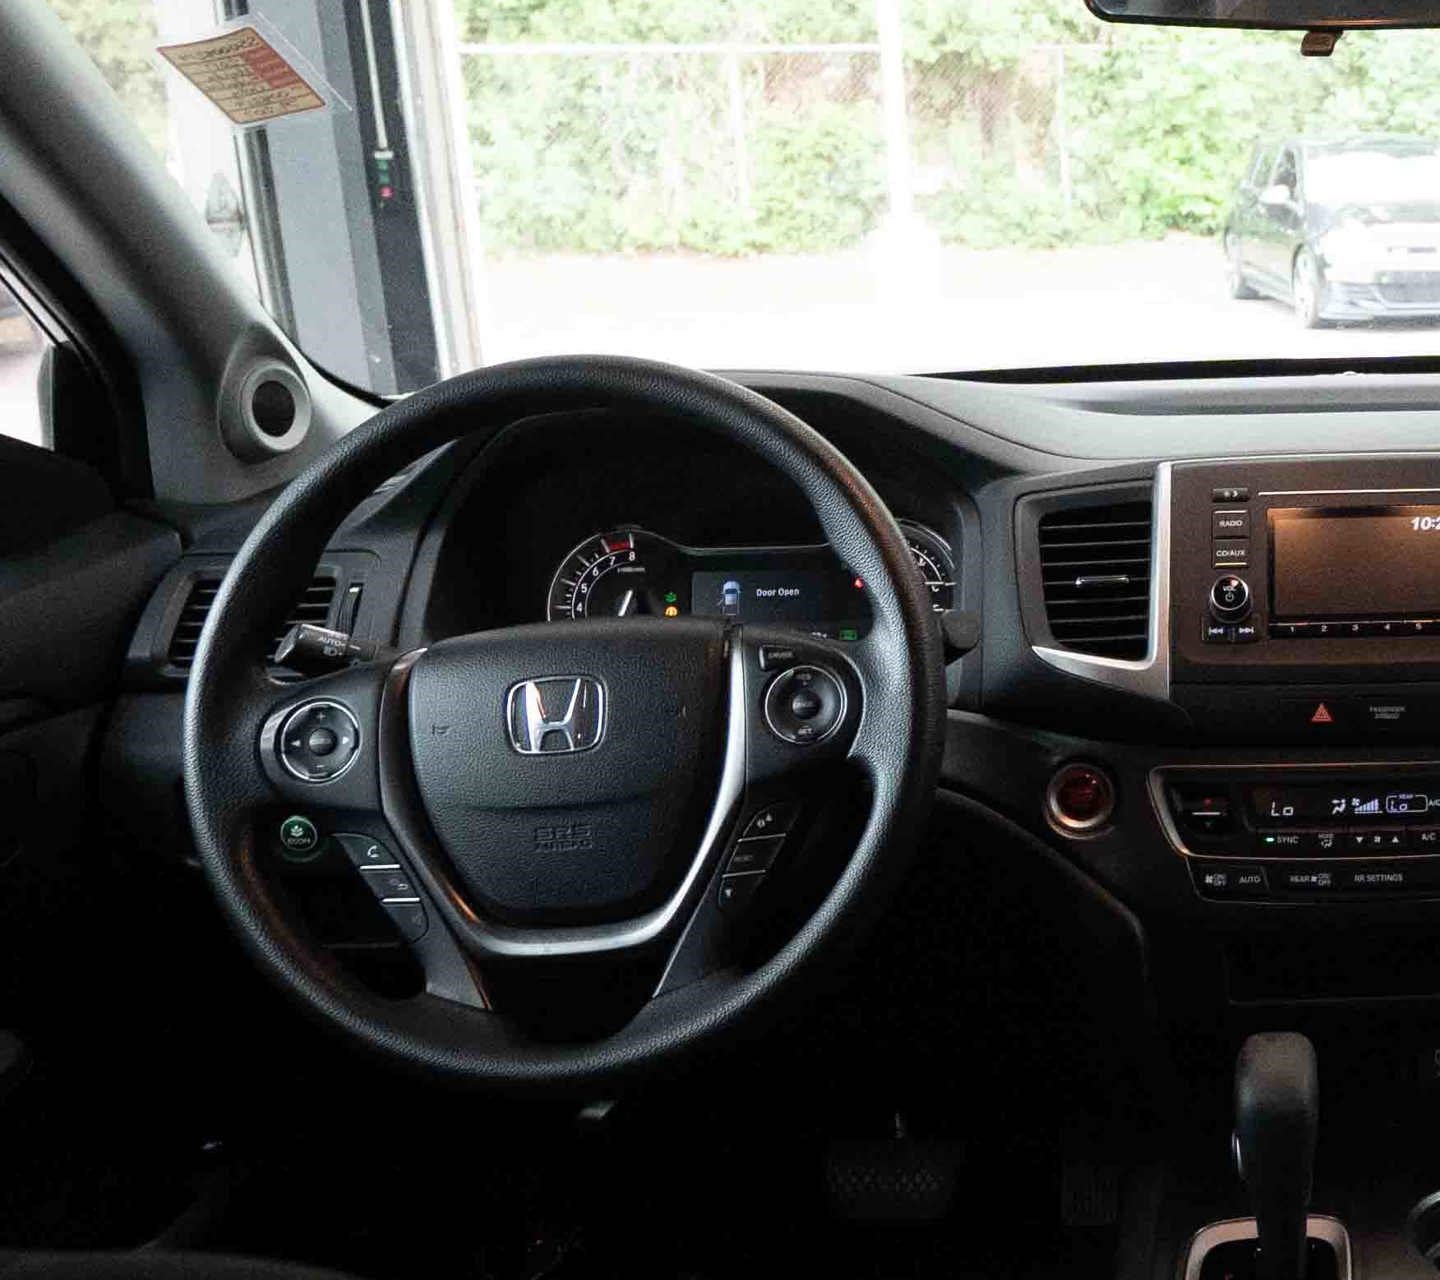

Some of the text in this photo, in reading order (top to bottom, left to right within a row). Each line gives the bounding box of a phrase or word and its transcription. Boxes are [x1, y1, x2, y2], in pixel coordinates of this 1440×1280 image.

[1218, 519, 1244, 528] RADIO
[608, 556, 616, 567] 7
[628, 551, 637, 562] 8
[592, 567, 600, 577] 6
[580, 583, 588, 593] 5
[755, 587, 800, 598] Door Open
[576, 602, 583, 612] 4
[1270, 800, 1294, 817] Lo
[1276, 835, 1300, 845] SYNC
[1421, 832, 1437, 841] A/C
[1238, 875, 1261, 884] AUTO
[1366, 873, 1404, 883] SETTINGS
